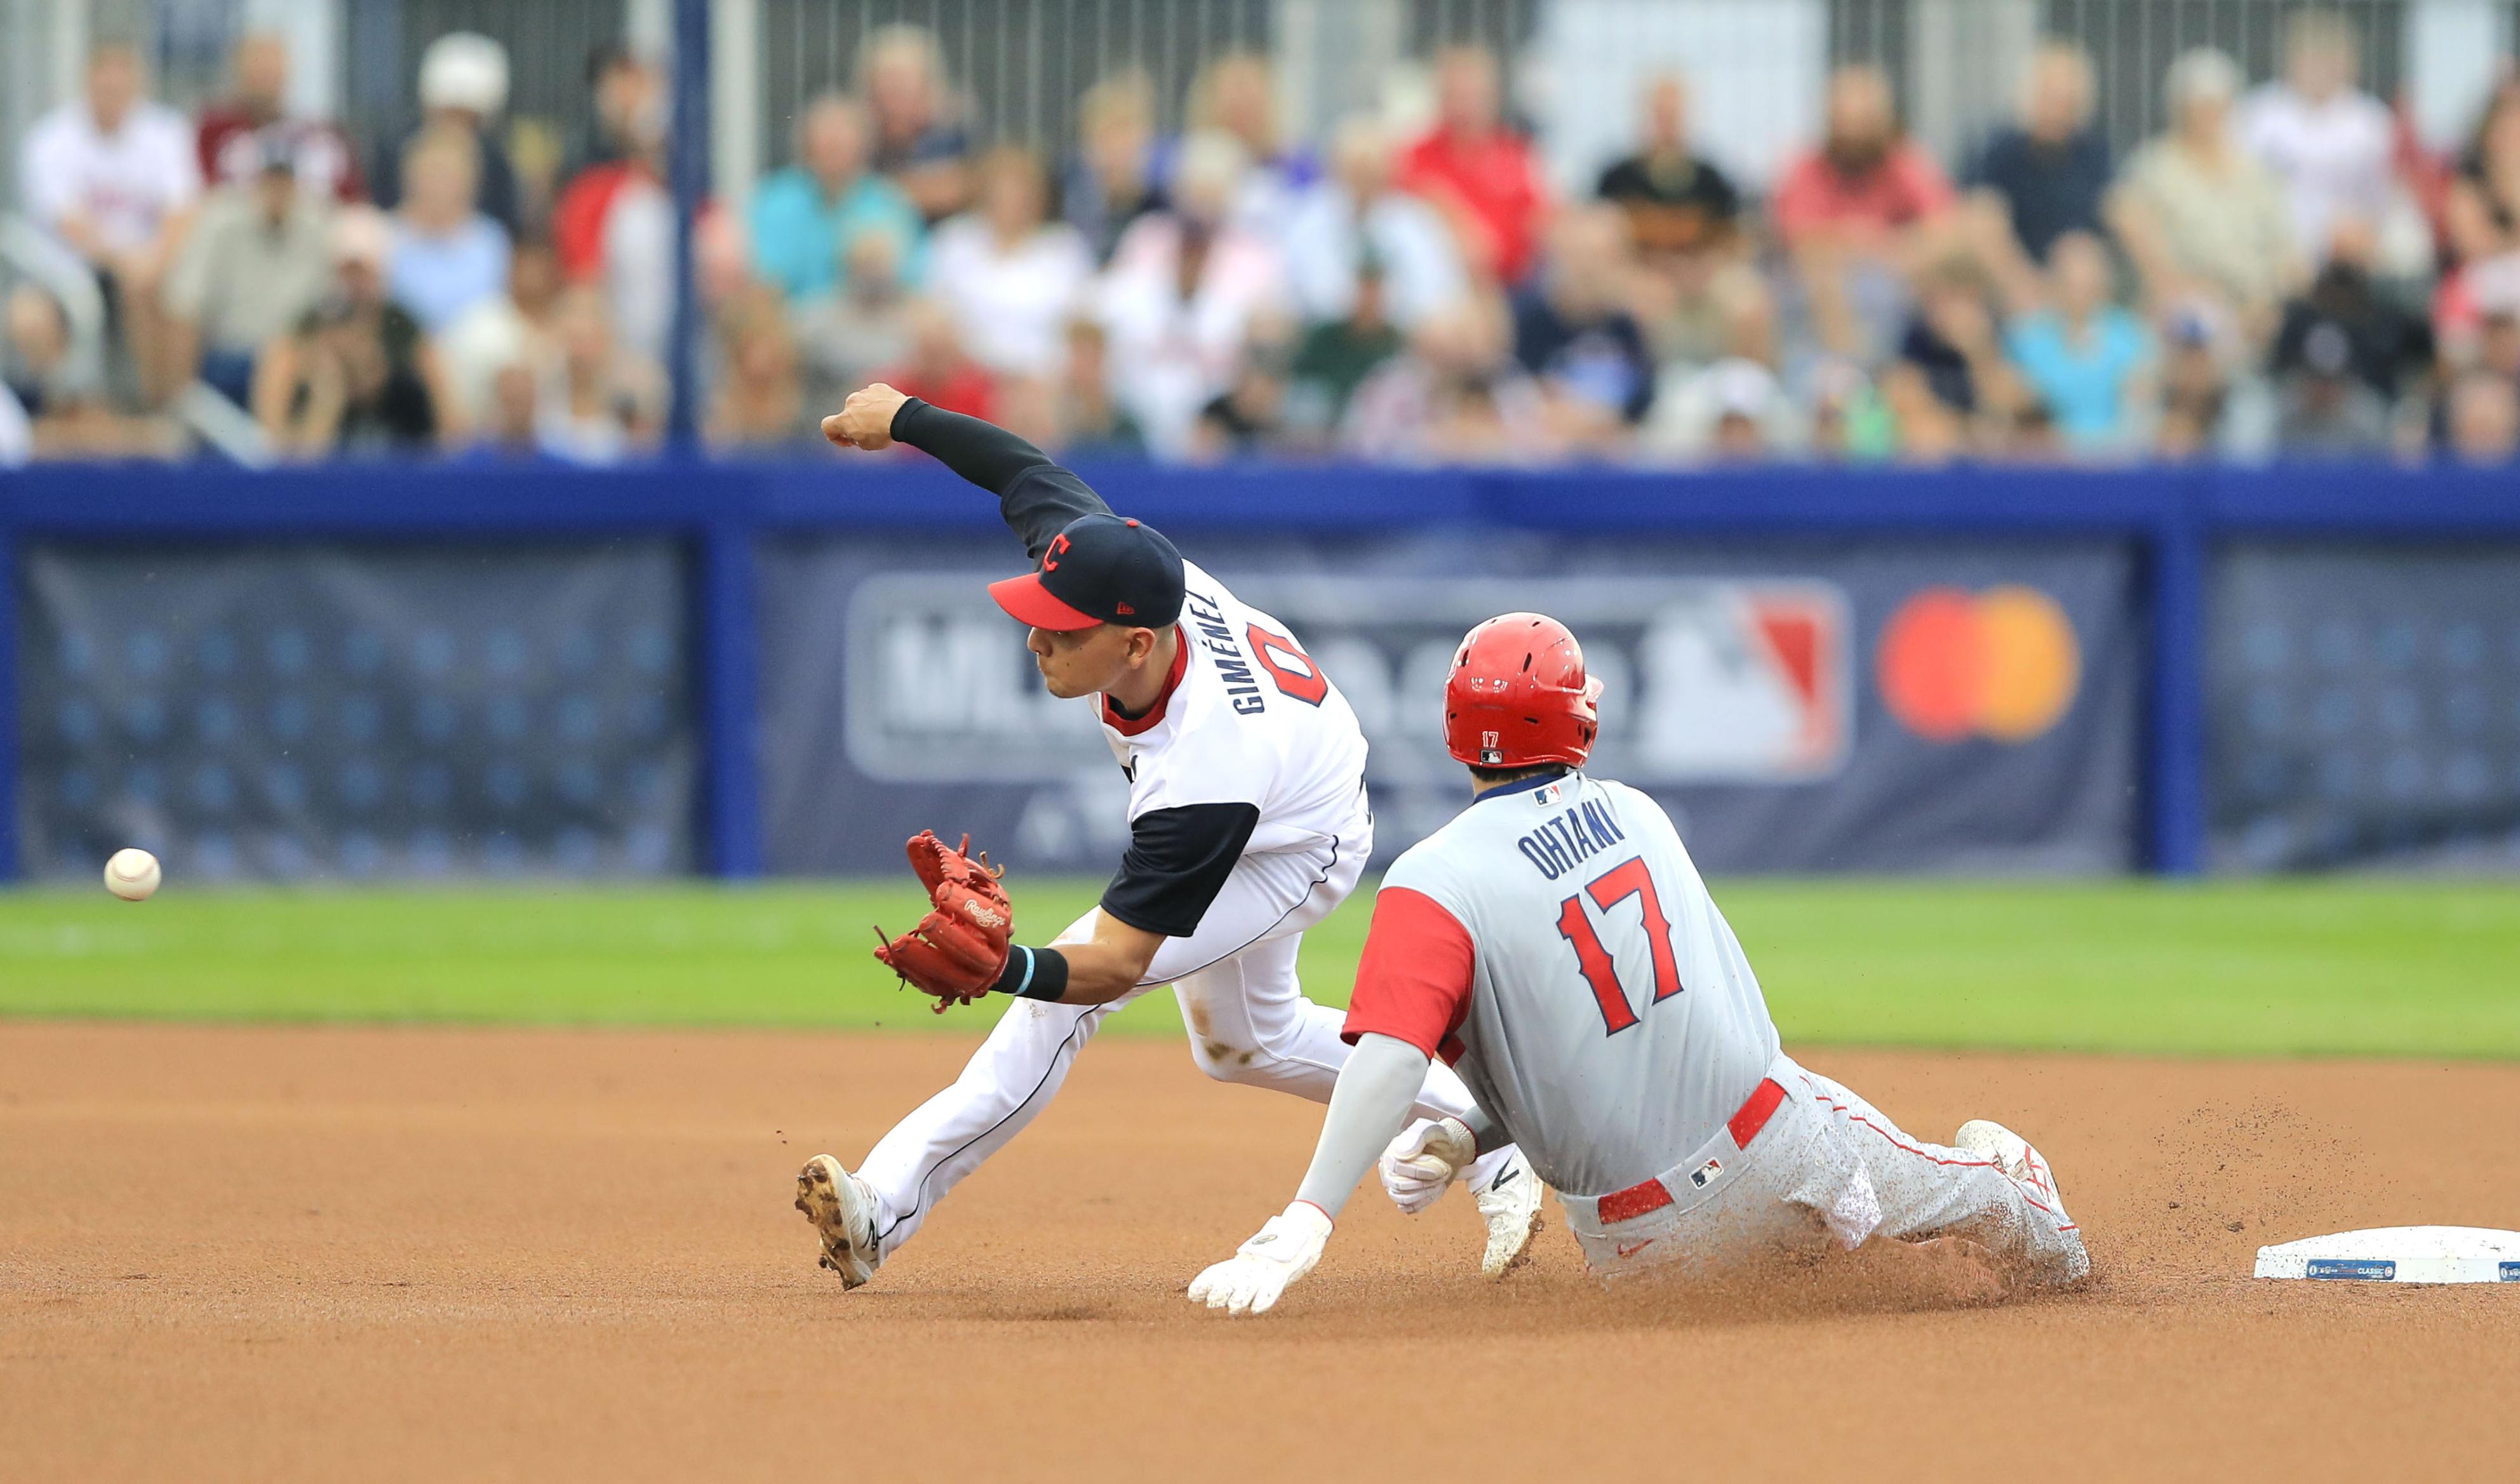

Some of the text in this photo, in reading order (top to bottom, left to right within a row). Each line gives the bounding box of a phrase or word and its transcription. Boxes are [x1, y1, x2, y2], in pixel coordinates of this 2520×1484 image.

[1043, 533, 1071, 572] C
[1185, 589, 1265, 715] GIMÉNEZ
[1245, 621, 1329, 708] 0
[1482, 730, 1499, 747] 17
[1517, 798, 1626, 881] OHTANI
[1555, 854, 1685, 1038] 17
